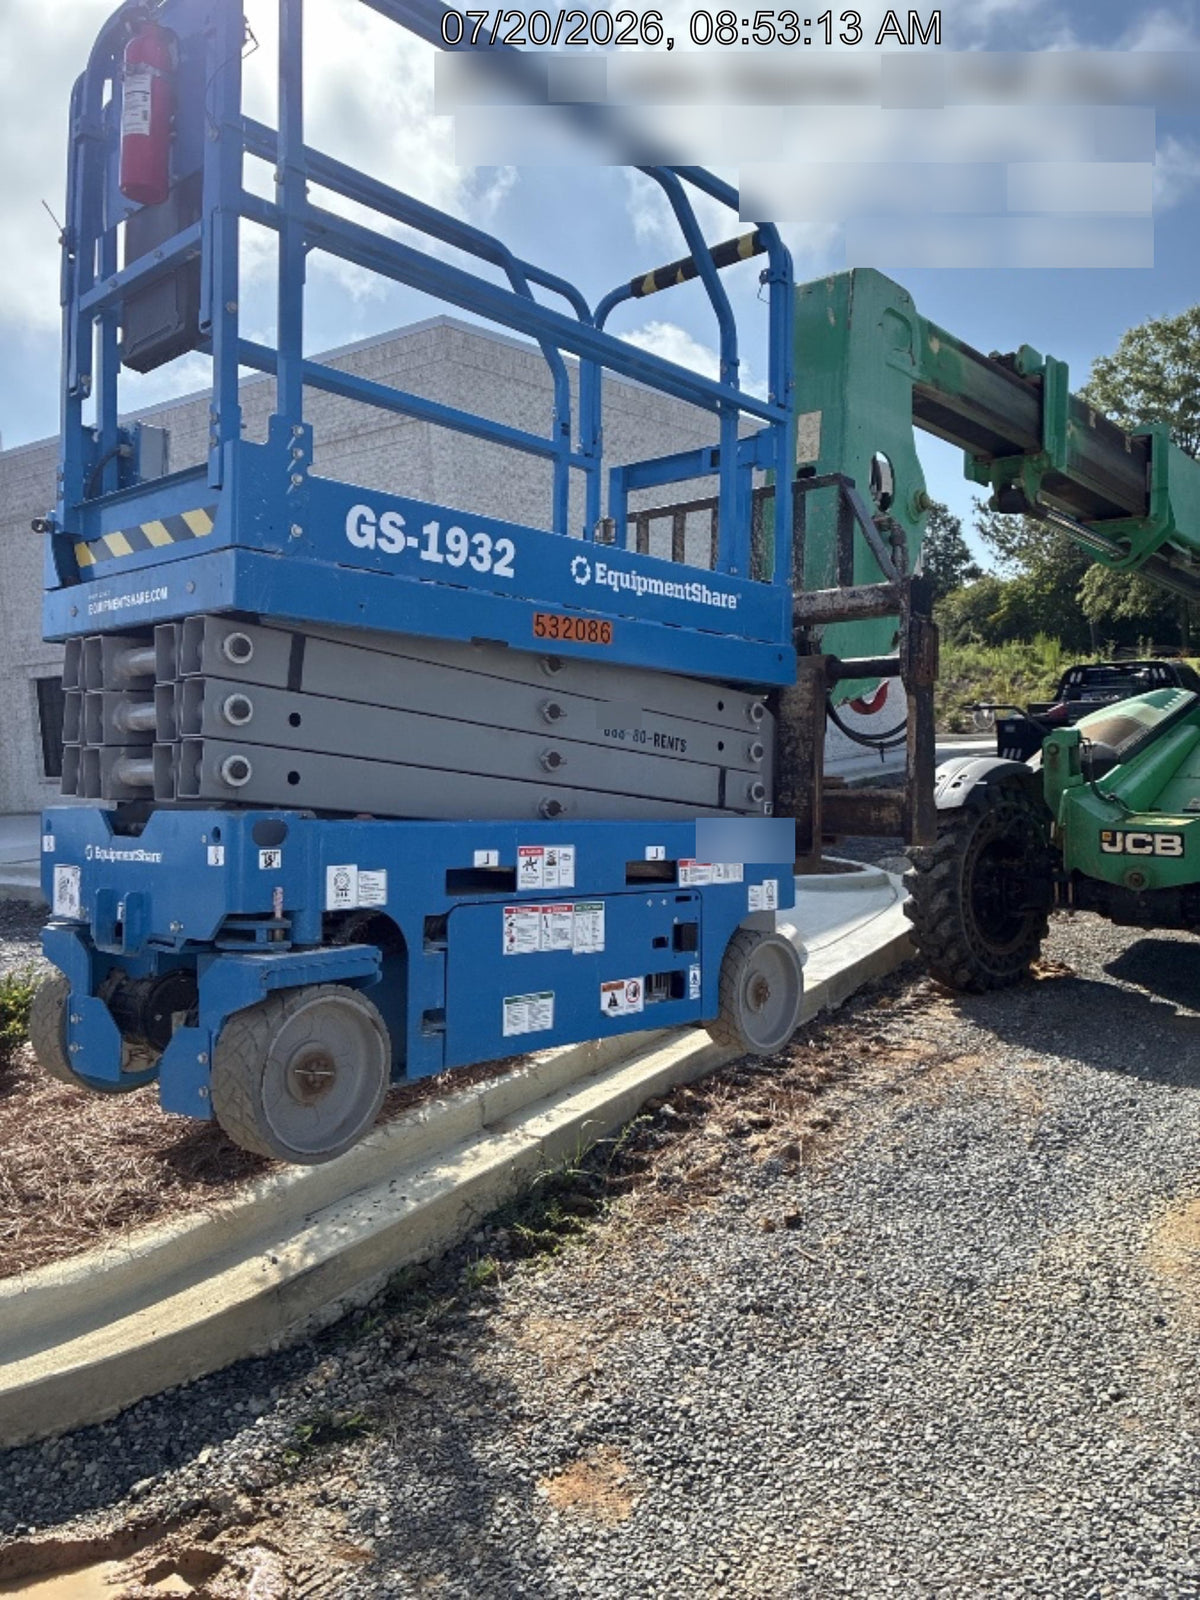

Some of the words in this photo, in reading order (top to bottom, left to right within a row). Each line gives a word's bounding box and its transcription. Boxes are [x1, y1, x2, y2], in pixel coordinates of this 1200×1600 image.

[345, 504, 517, 579] GS-1932
[594, 561, 738, 610] EquipmentShare
[534, 613, 612, 645] 532086
[1101, 831, 1184, 857] JCB
